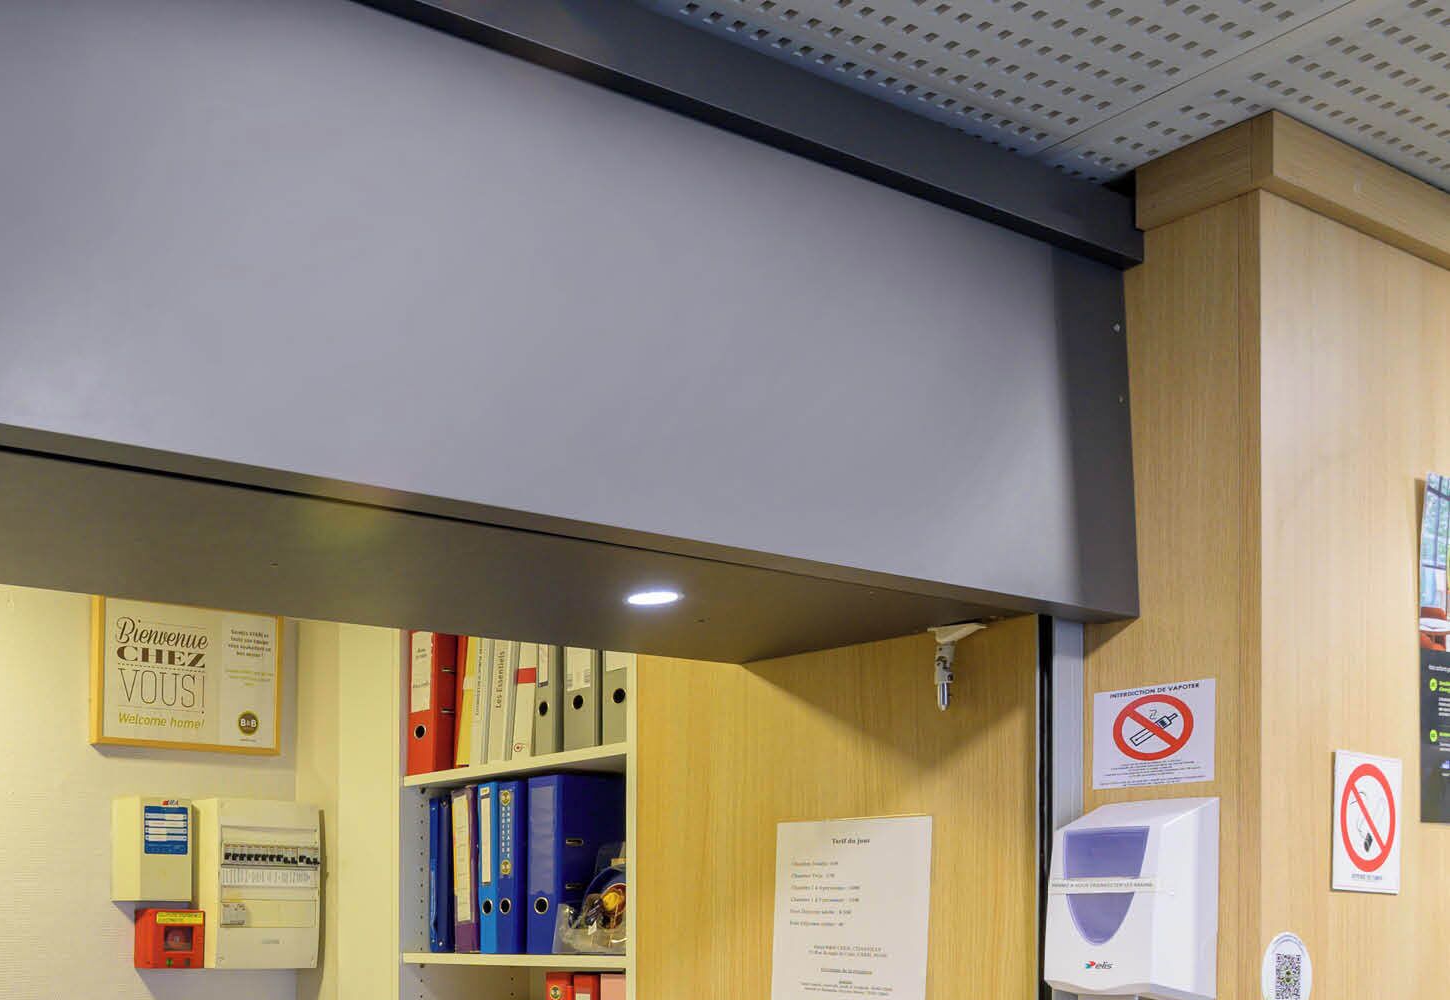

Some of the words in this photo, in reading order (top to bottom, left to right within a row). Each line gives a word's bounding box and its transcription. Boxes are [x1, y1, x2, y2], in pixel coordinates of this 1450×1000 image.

[116, 617, 208, 649] Bienvenue
[117, 645, 206, 668] CHEZ
[118, 668, 205, 714] VOUS!
[1110, 689, 1155, 699] INTERDICTION
[1168, 683, 1200, 691] VAPOTER
[118, 712, 167, 727] Welcome
[170, 717, 205, 729] home!
[1095, 961, 1113, 970] elis
